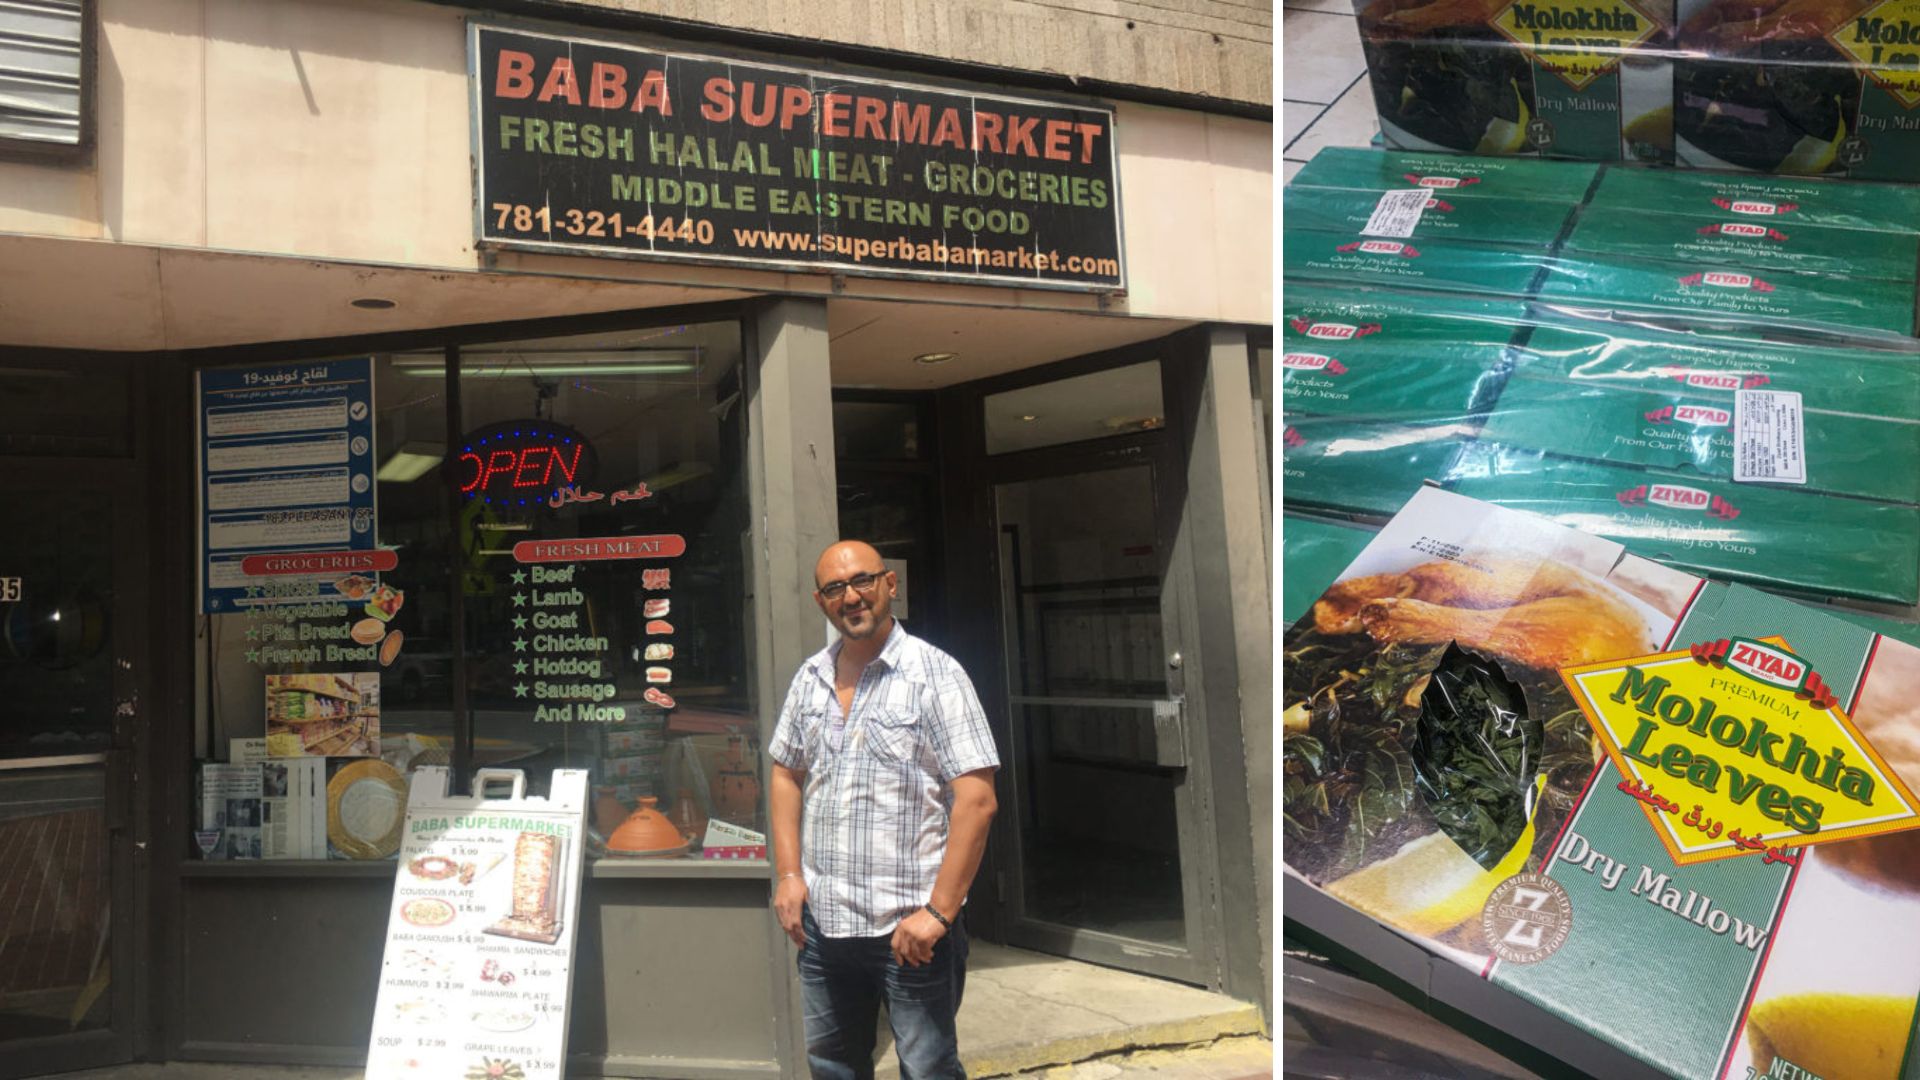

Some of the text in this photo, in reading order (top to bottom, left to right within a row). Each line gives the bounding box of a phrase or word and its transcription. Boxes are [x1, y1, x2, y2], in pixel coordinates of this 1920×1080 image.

[1513, 3, 1638, 32] Molokhia
[495, 49, 1103, 165] BABA SUPERMARKET
[1537, 97, 1618, 113] Dry Mallow
[1859, 113, 1887, 131] Dry
[500, 114, 635, 164] FRESH
[650, 129, 782, 179] HALAL
[793, 146, 894, 188] MEAT
[923, 159, 1109, 210] GROCERIES
[610, 173, 1031, 237] MIDDLE EASTERN FOOD
[1734, 203, 1774, 213] ZIYAD
[1724, 225, 1764, 235] ZIYAD
[493, 203, 1120, 279] 781-321-4440 www.superbabamarket.com
[1705, 273, 1750, 285] ZIYAD
[1309, 326, 1353, 338] ZIYAD
[1689, 375, 1738, 388] ZIYAD
[1676, 407, 1729, 424] ZIYAD
[1614, 434, 1646, 447] From
[1648, 440, 1676, 451] Our
[1642, 427, 1690, 443] Quality
[460, 444, 584, 492] OPEN
[548, 486, 605, 509] حلال
[1651, 486, 1708, 506] ZIYAD
[535, 540, 665, 557] FRESH MEAT
[1716, 539, 1757, 555] Yours
[265, 555, 374, 571] GROCERIES
[531, 564, 576, 584] Beef
[532, 588, 584, 606] Lamb
[263, 600, 349, 623] Vegetable
[532, 611, 579, 629] Goat
[261, 621, 351, 642] Pita Bread
[532, 633, 609, 653] Chicken
[261, 643, 378, 664] French Bread
[1731, 644, 1802, 682] ZIYAD
[533, 657, 602, 679] Hotdog
[534, 681, 617, 703] Sausage
[1710, 678, 1800, 721] PREMIUM
[533, 703, 627, 723] And More
[1609, 665, 1875, 806] Molokhia
[1621, 716, 1823, 834] Leaves
[412, 817, 450, 834] BABA
[1682, 805, 1724, 839] ورق
[1492, 874, 1571, 913] PREMIUM QUALITY
[1559, 832, 1767, 951] Dry Mallow
[386, 978, 429, 988] HUMMUS
[377, 1036, 403, 1047] SOUP
[464, 1042, 496, 1053] GRAPE
